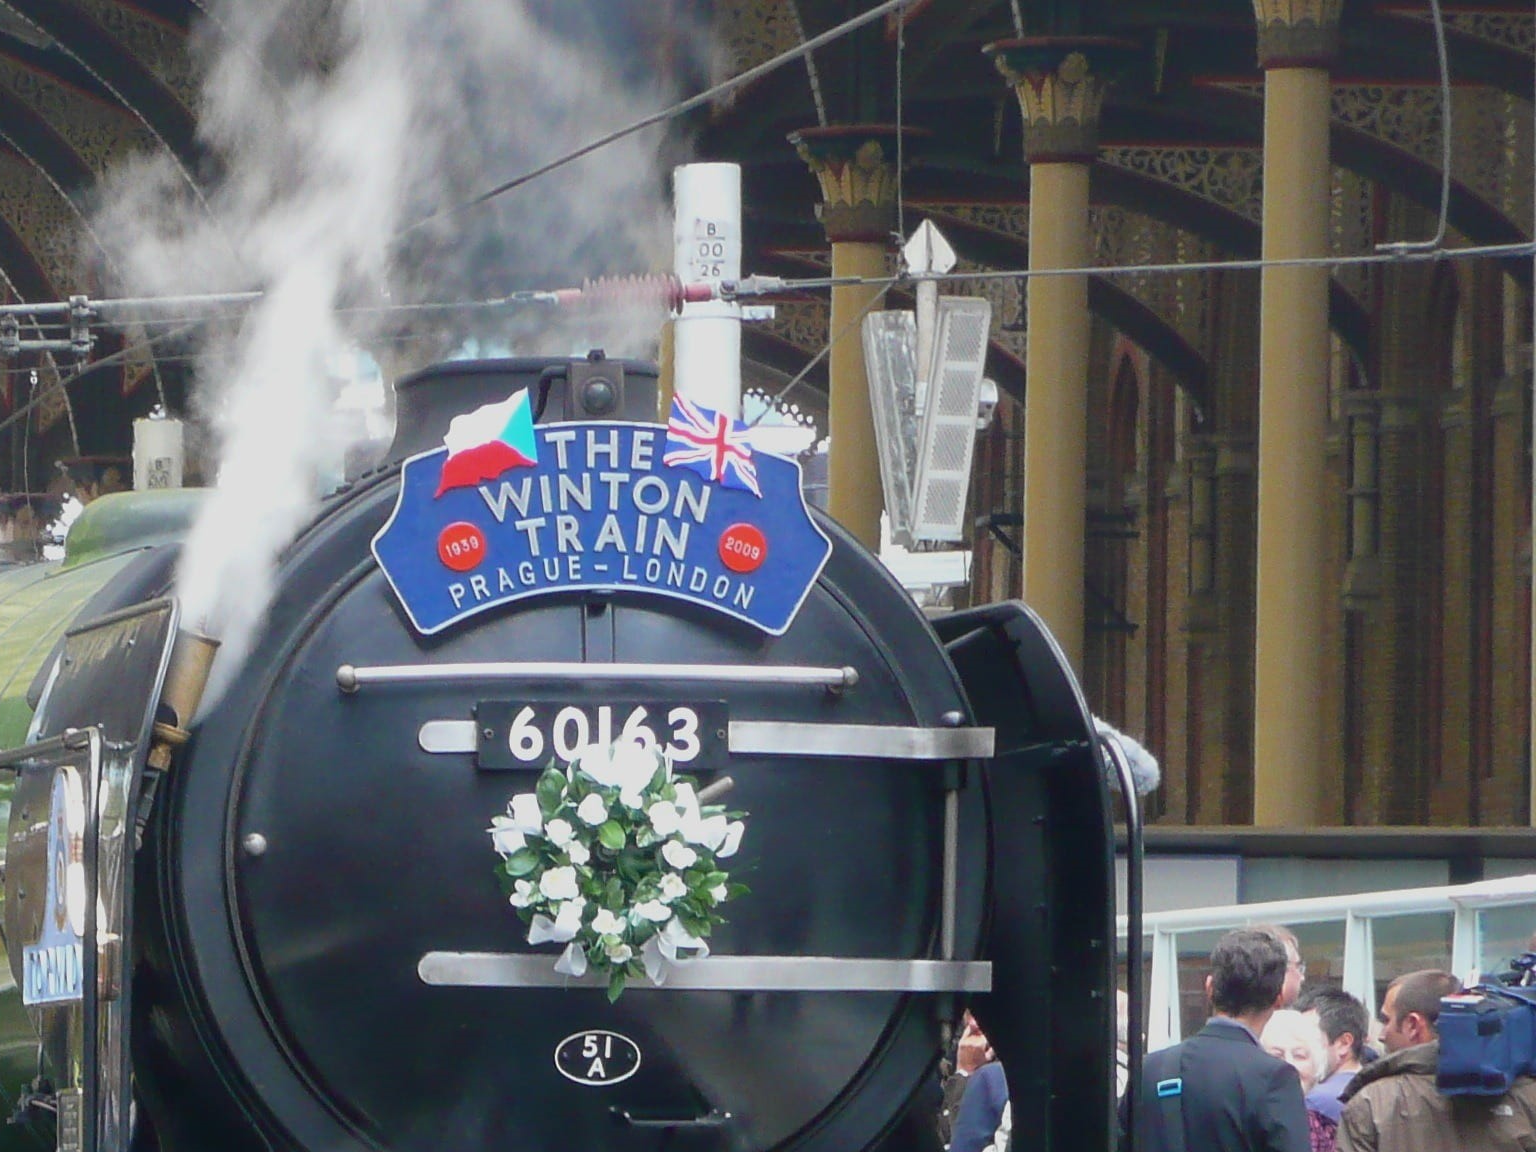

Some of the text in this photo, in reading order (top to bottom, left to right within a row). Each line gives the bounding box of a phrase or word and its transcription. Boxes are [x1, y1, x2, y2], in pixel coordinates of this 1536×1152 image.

[545, 430, 654, 469] THE
[478, 472, 712, 524] WINTON
[445, 535, 479, 558] 1939
[515, 514, 691, 560] TRAIN
[724, 536, 760, 560] 2009
[448, 556, 582, 609] PRAGUE
[622, 556, 755, 610] LONDON
[509, 706, 700, 762] 60163
[582, 1034, 612, 1058] 51
[586, 1057, 606, 1078] A
